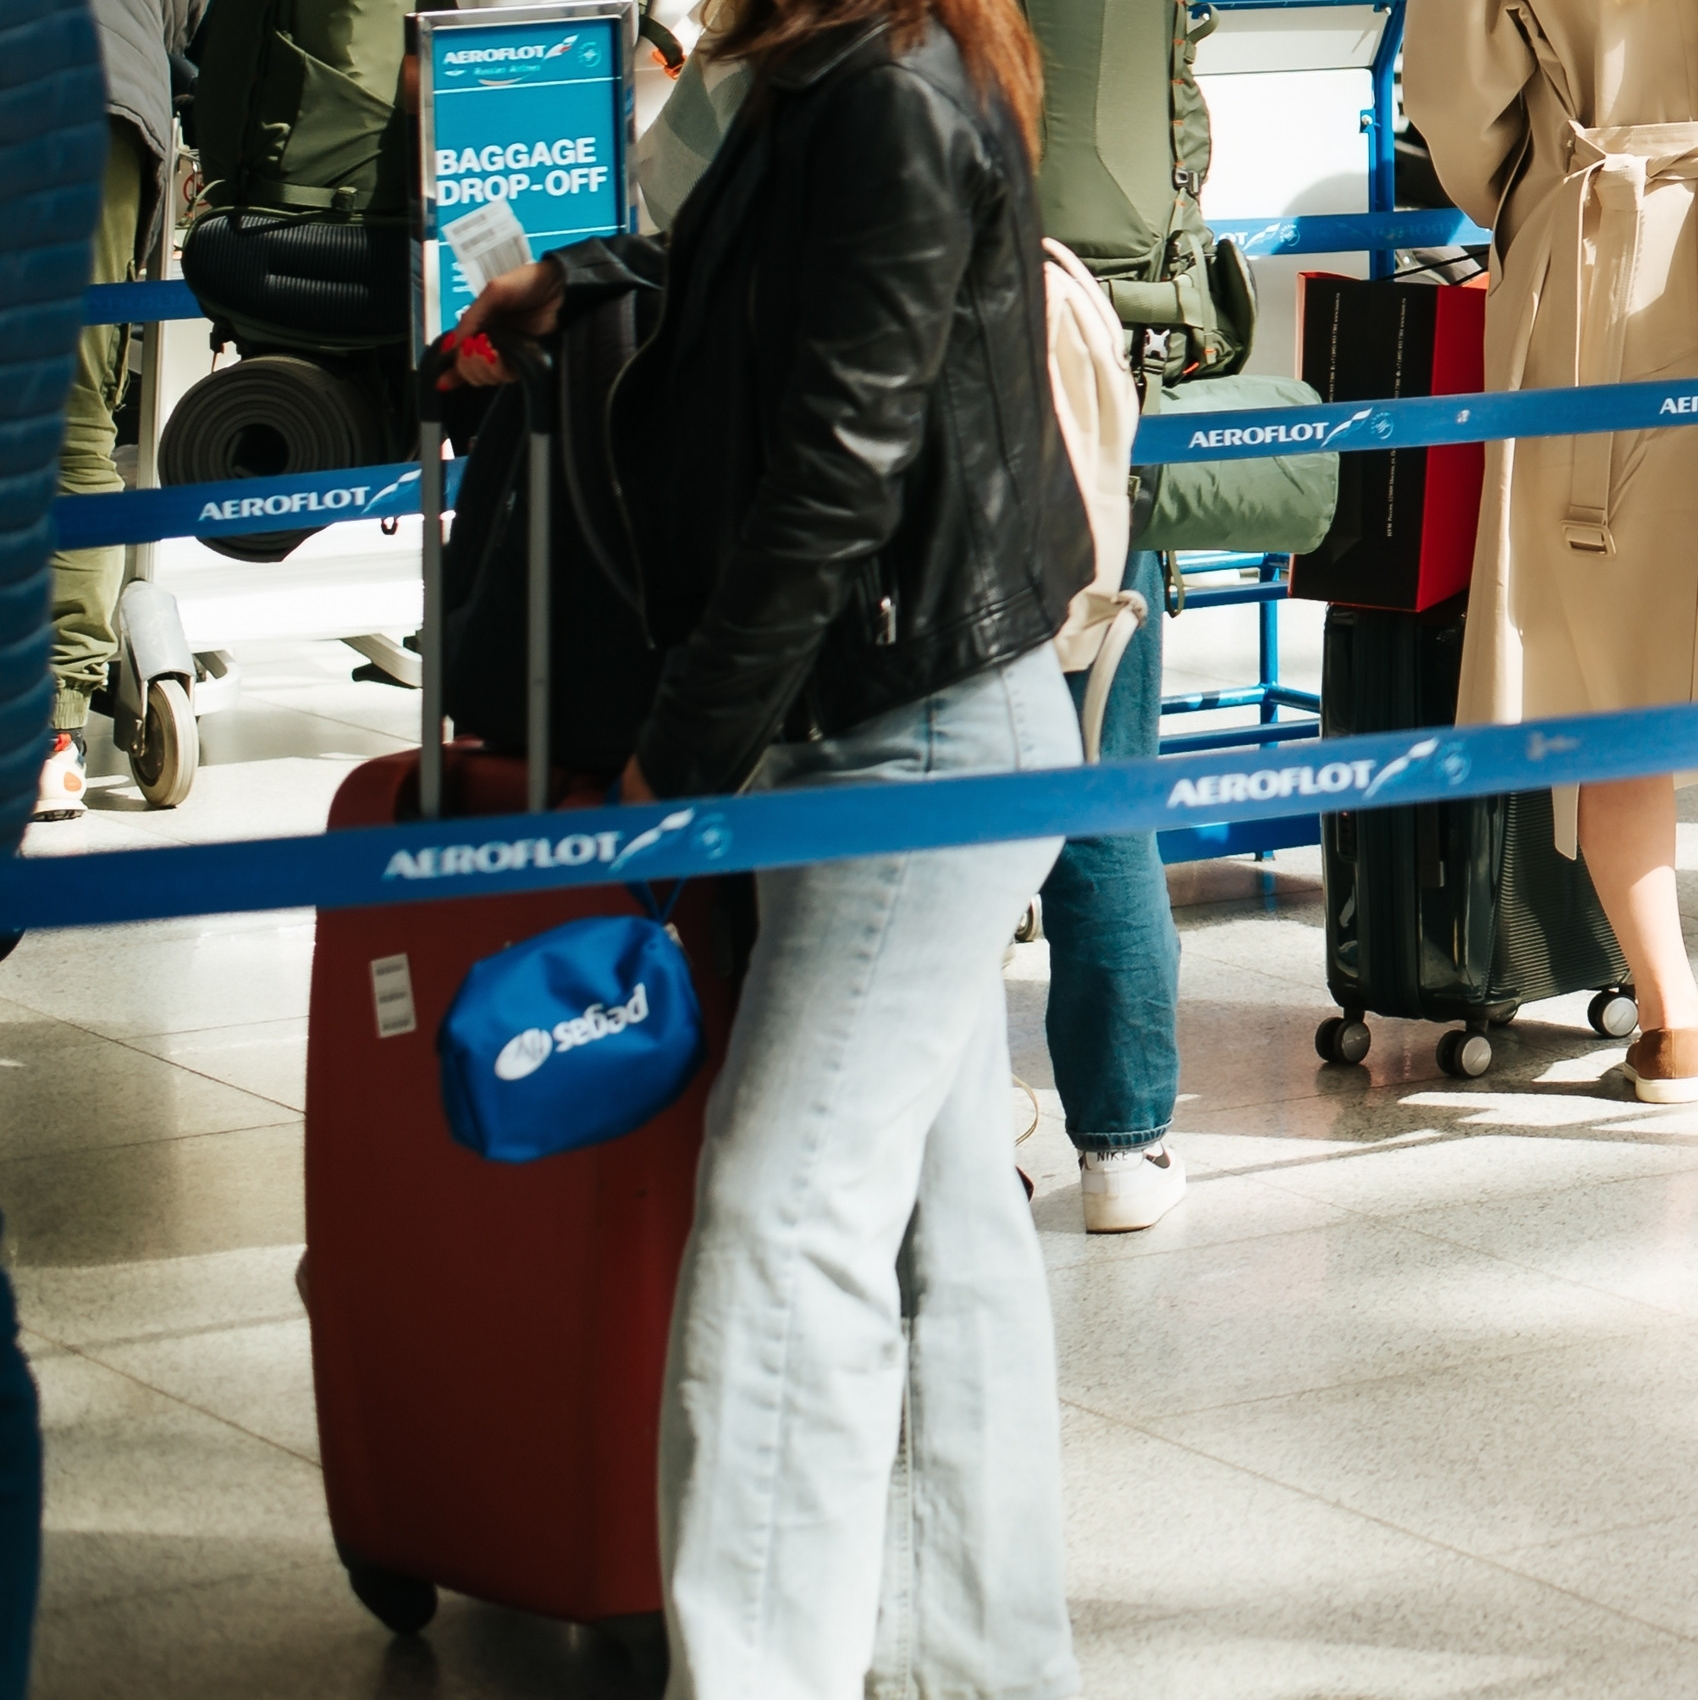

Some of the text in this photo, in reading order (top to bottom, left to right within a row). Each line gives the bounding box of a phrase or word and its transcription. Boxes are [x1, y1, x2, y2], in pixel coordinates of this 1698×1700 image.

[443, 45, 547, 66] AEROFLOT
[435, 136, 598, 177] BAGGAGE
[435, 166, 609, 207] DROP-OFF
[1188, 422, 1330, 449] AEROFLOT
[198, 486, 371, 522] AEROFLOT
[1166, 759, 1376, 809] AEROFLOT
[381, 830, 624, 881] AEROFLOT
[552, 982, 650, 1054] pegas
